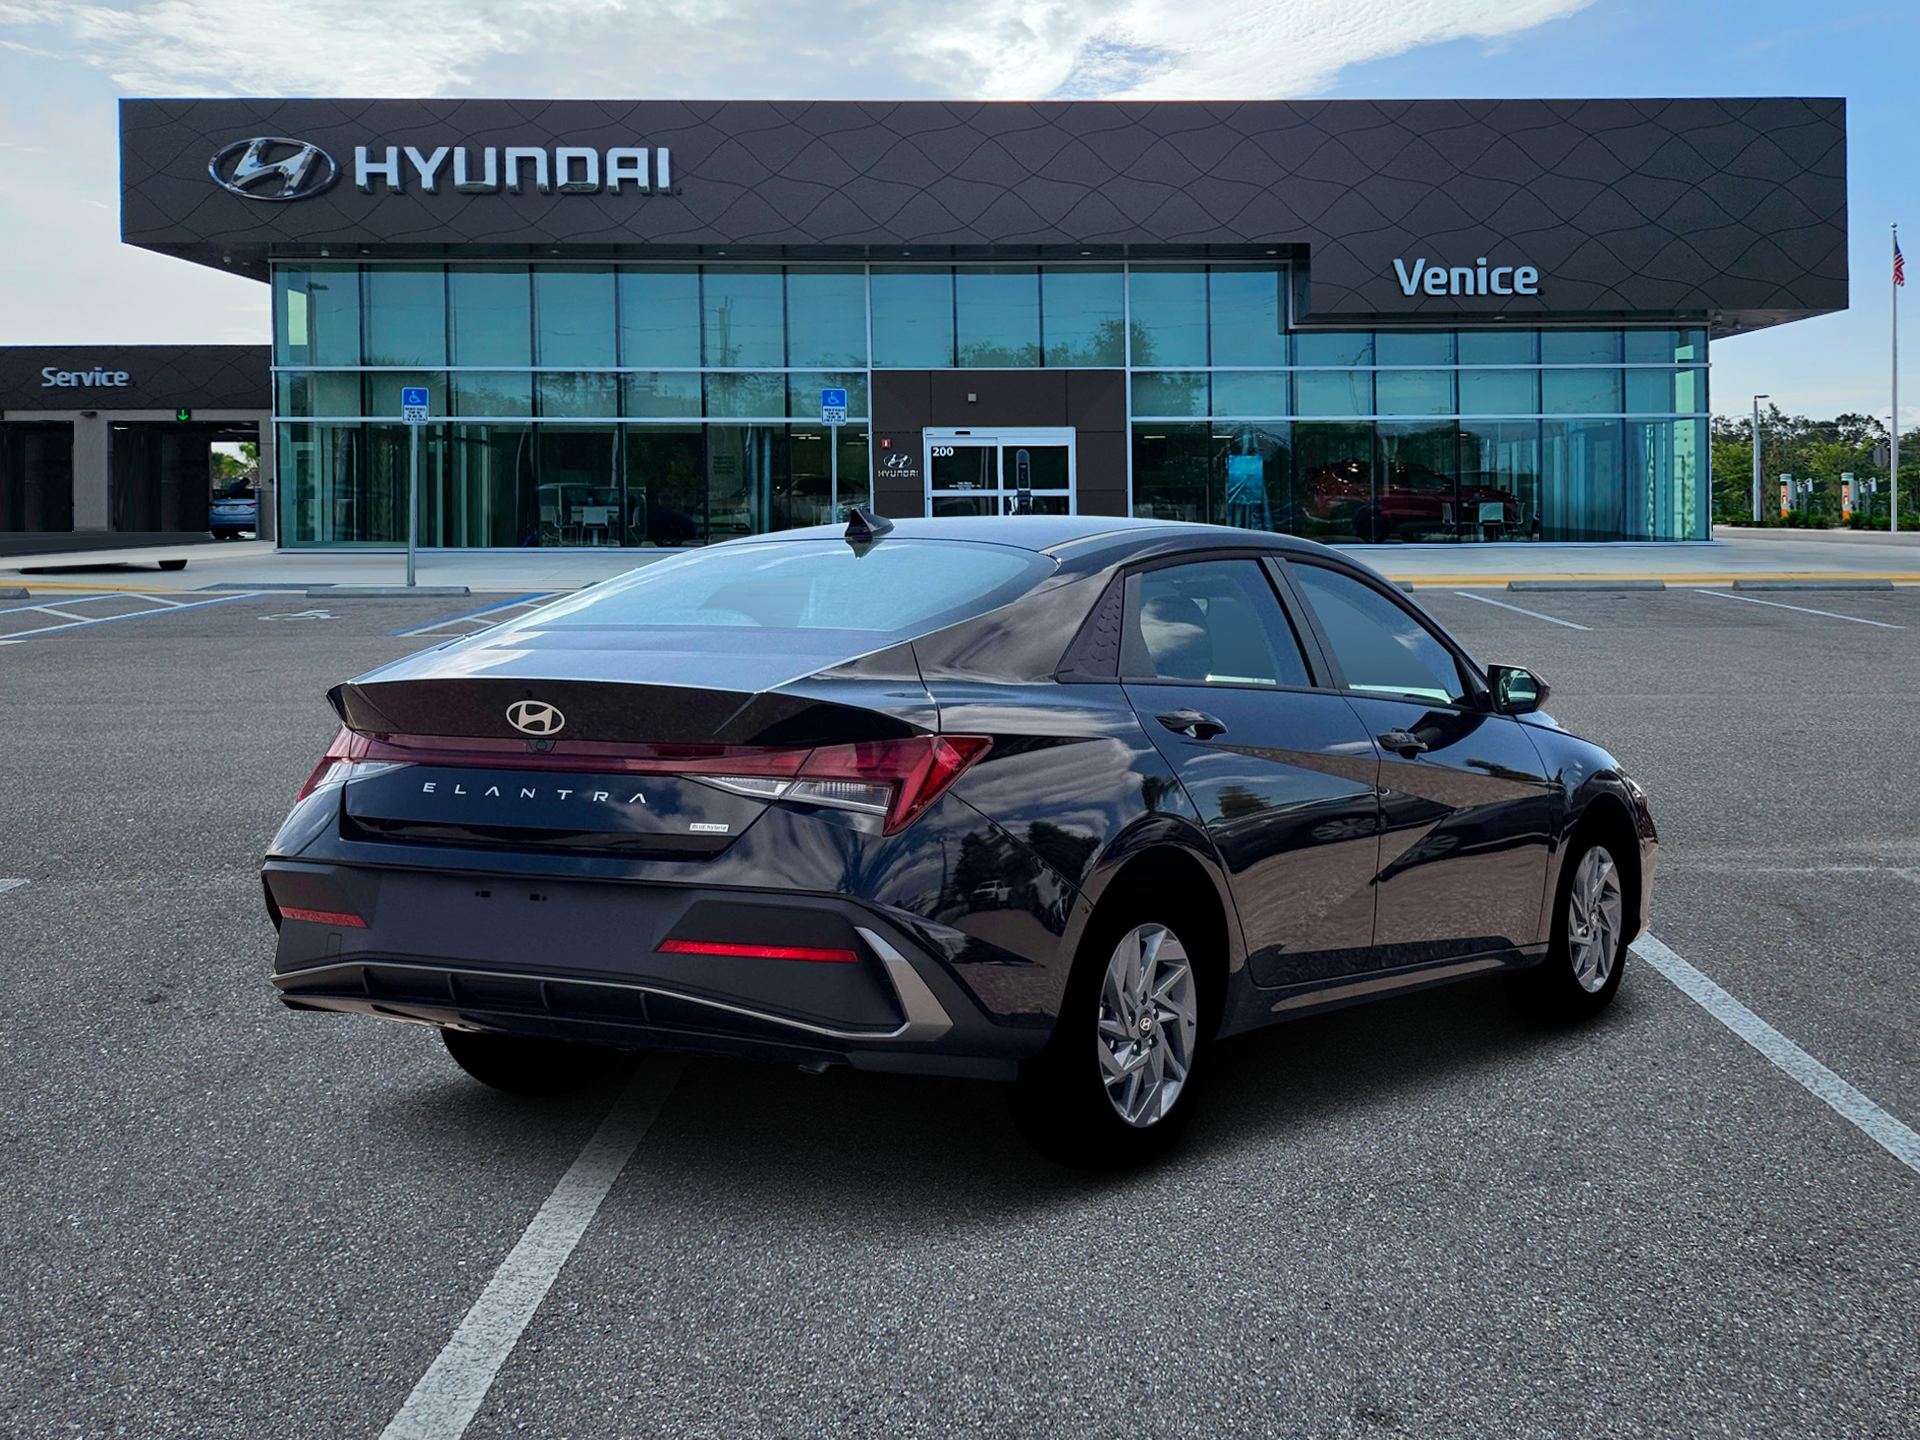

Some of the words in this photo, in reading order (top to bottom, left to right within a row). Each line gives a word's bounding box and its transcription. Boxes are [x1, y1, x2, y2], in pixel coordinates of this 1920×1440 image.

[354, 146, 673, 194] HYUNDAI
[1393, 257, 1539, 296] Venice
[41, 366, 130, 387] Service
[932, 446, 954, 457] 200
[877, 470, 919, 478] HYUNDAI
[422, 782, 647, 804] ELANTRA
